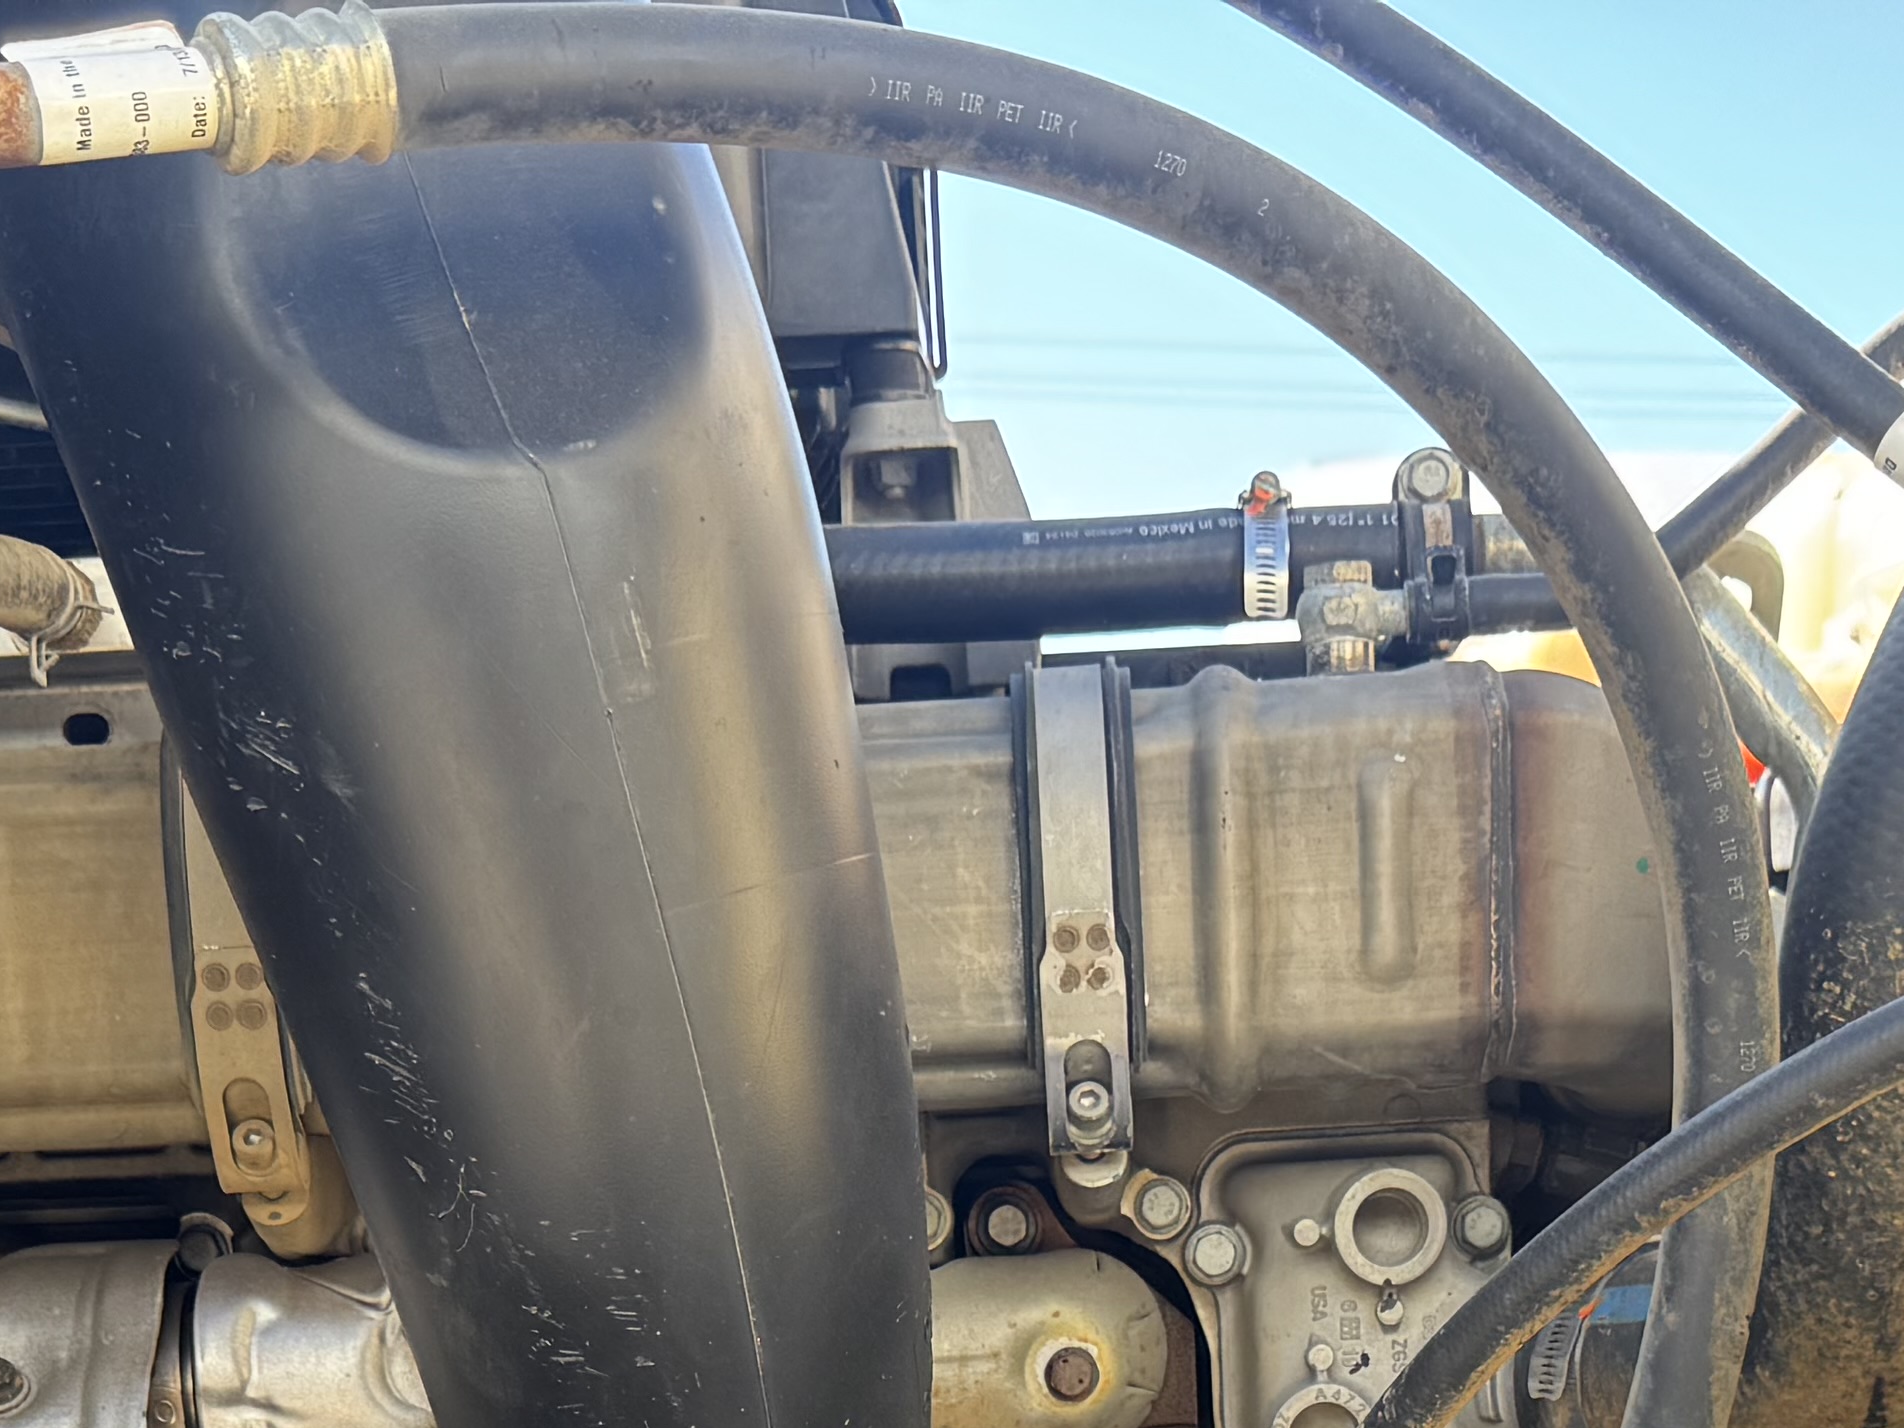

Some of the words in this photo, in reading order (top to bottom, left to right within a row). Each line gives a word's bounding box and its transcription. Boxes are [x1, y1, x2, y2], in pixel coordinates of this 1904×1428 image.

[191, 96, 207, 138] Date:
[925, 85, 944, 107] PA
[959, 92, 985, 115] IIR
[997, 100, 1024, 124] PET
[75, 105, 93, 151] Made
[1153, 149, 1188, 178] 1270
[1138, 521, 1196, 539] Mexico
[1197, 519, 1214, 532] in
